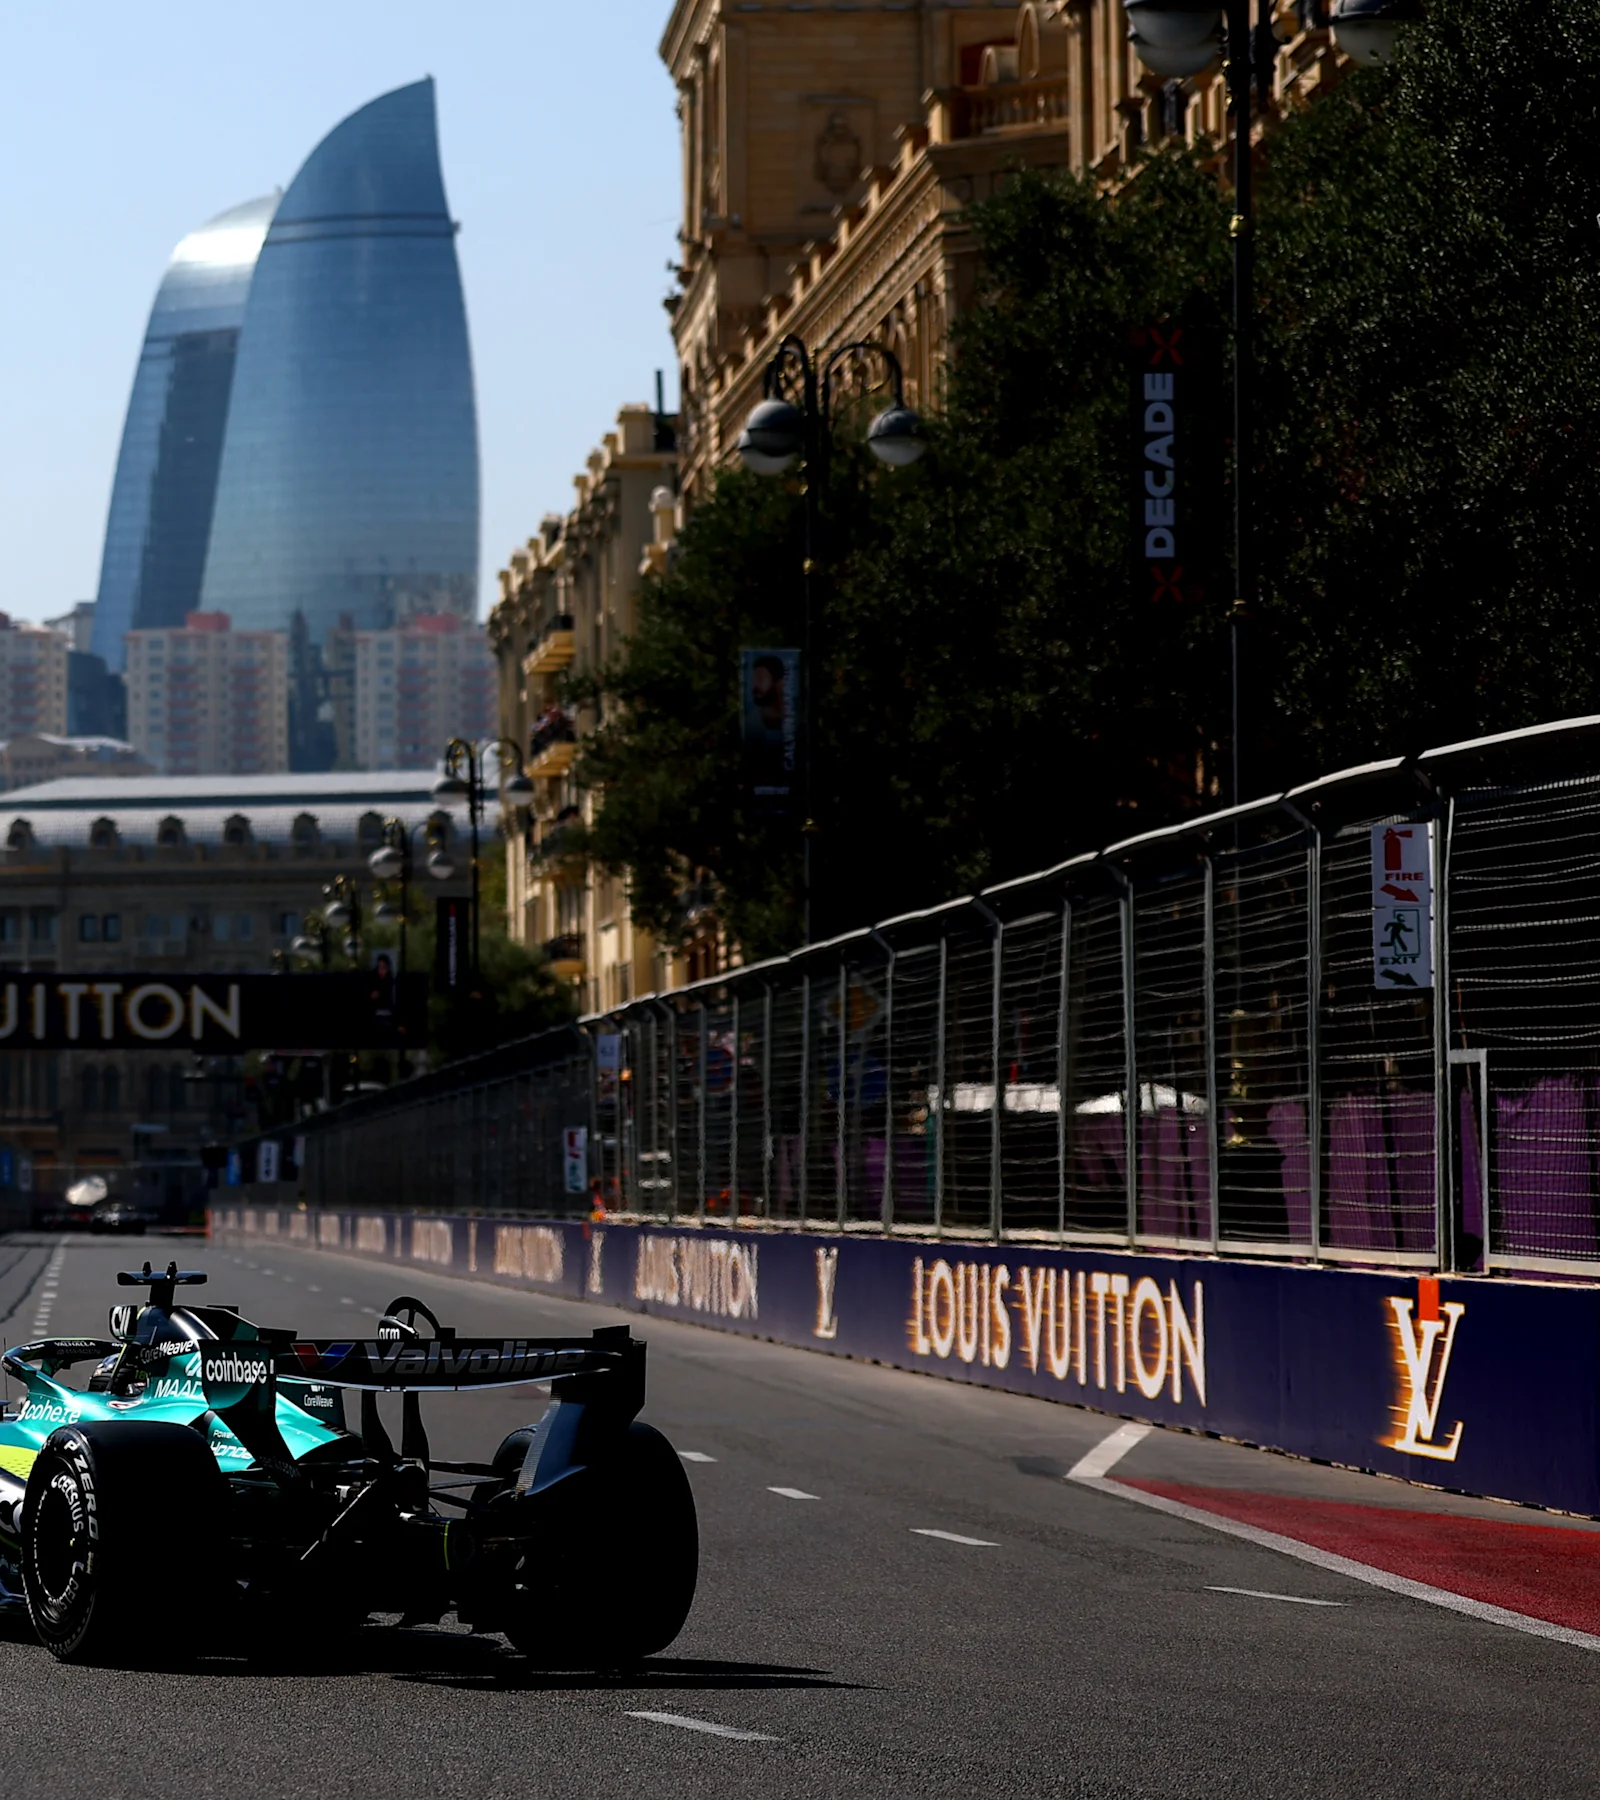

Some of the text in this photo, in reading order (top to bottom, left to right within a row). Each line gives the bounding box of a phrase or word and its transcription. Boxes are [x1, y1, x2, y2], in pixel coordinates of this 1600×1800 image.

[1144, 372, 1176, 558] DECADE
[1385, 872, 1424, 881] FIRE
[1379, 956, 1418, 966] EXIT
[378, 1327, 401, 1341] arm
[912, 1256, 1207, 1408] LOUIS VUITTON
[139, 1339, 195, 1365] CoreWeave
[363, 1340, 587, 1376] Valvoline
[205, 1352, 267, 1385] coinbase
[24, 1399, 82, 1425] cohere
[303, 1393, 334, 1408] CoreWeave
[57, 1474, 85, 1533] CELSIUS
[73, 1454, 100, 1542] ZERO
